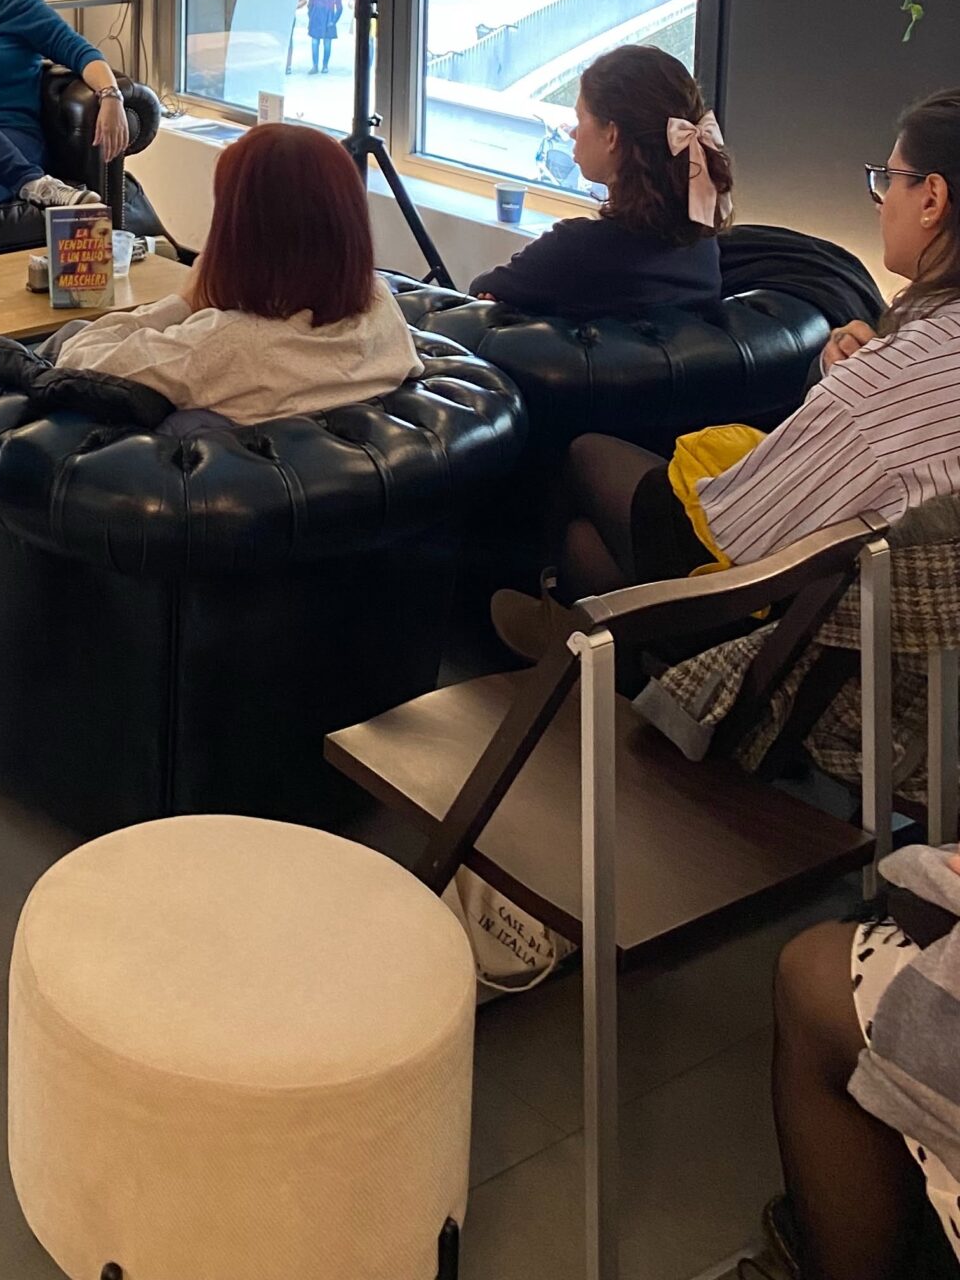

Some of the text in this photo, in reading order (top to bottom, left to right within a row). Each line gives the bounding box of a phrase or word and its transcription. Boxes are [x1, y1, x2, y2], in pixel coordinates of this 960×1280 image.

[59, 239, 104, 250] VENDETTA
[77, 263, 88, 273] IN
[59, 274, 105, 286] MASCHERA
[498, 906, 525, 939] CASE
[527, 935, 541, 954] DI
[478, 915, 494, 932] IN
[497, 929, 537, 967] ITALIA
